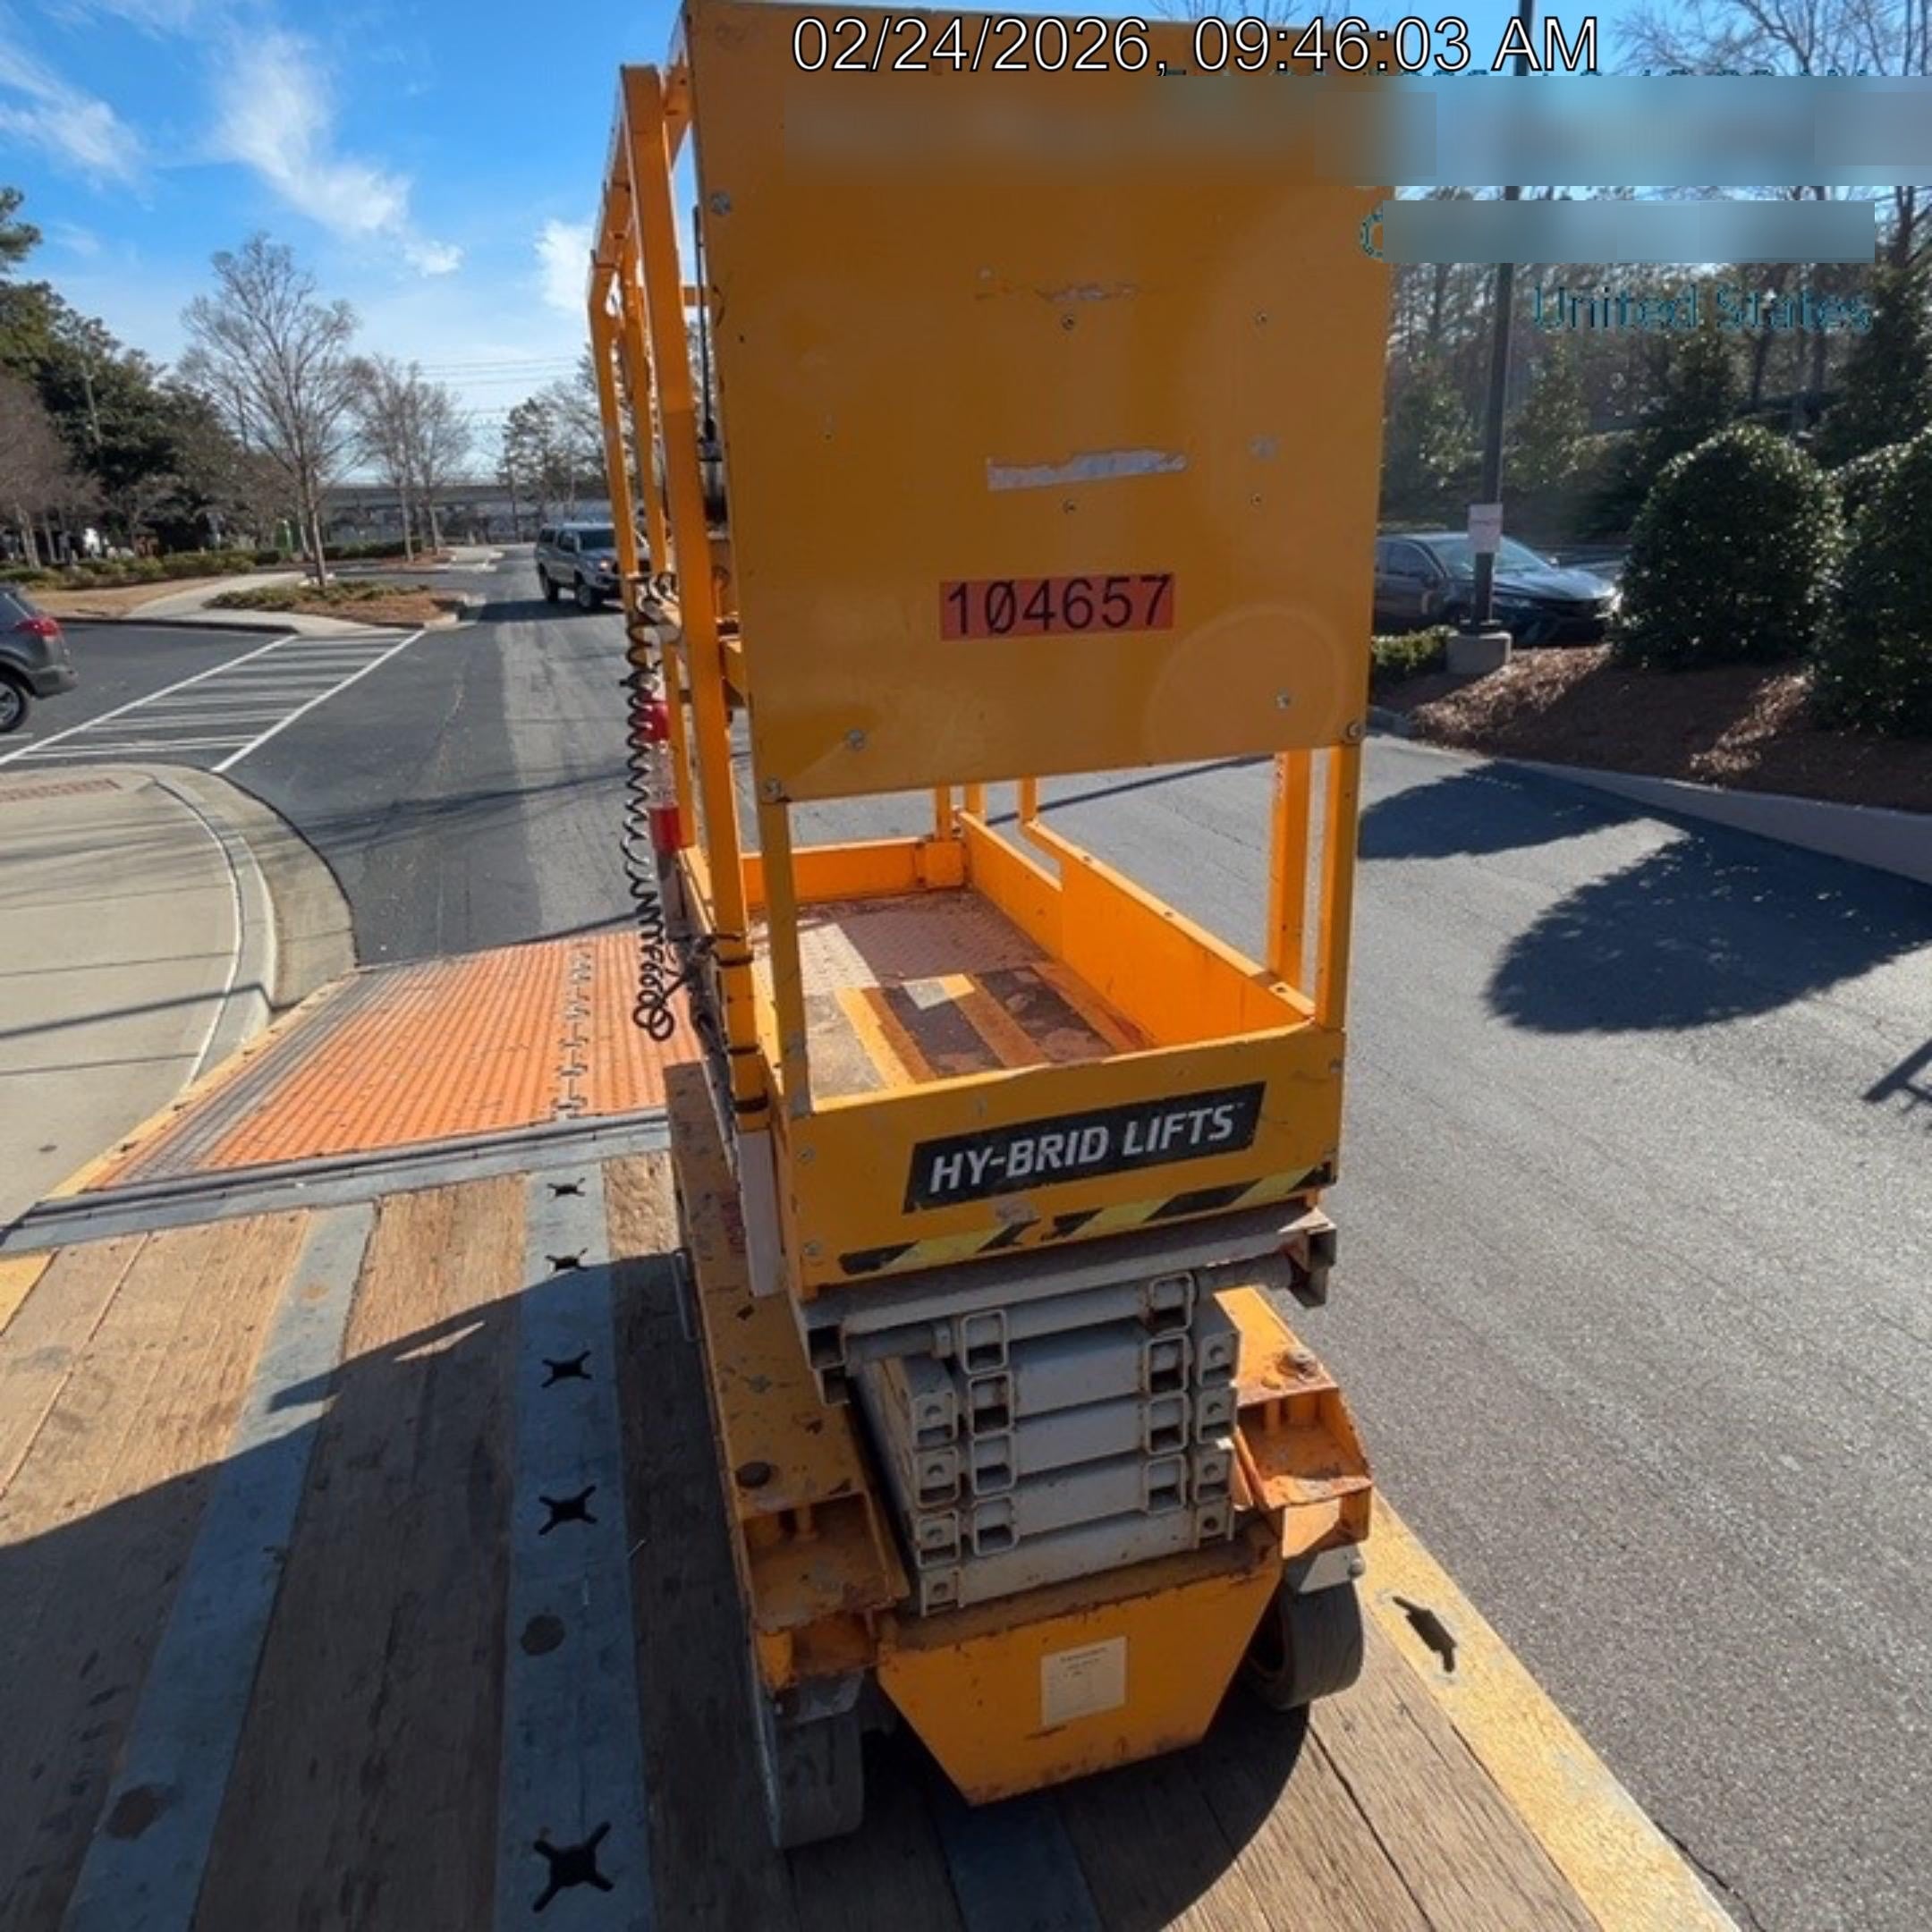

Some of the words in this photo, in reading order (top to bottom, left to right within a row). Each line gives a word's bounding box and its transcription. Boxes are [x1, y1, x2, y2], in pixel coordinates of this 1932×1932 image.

[948, 573, 1173, 636] 104657
[929, 1125, 1109, 1194] HY-BRID
[1122, 1103, 1236, 1156] LIFTS
